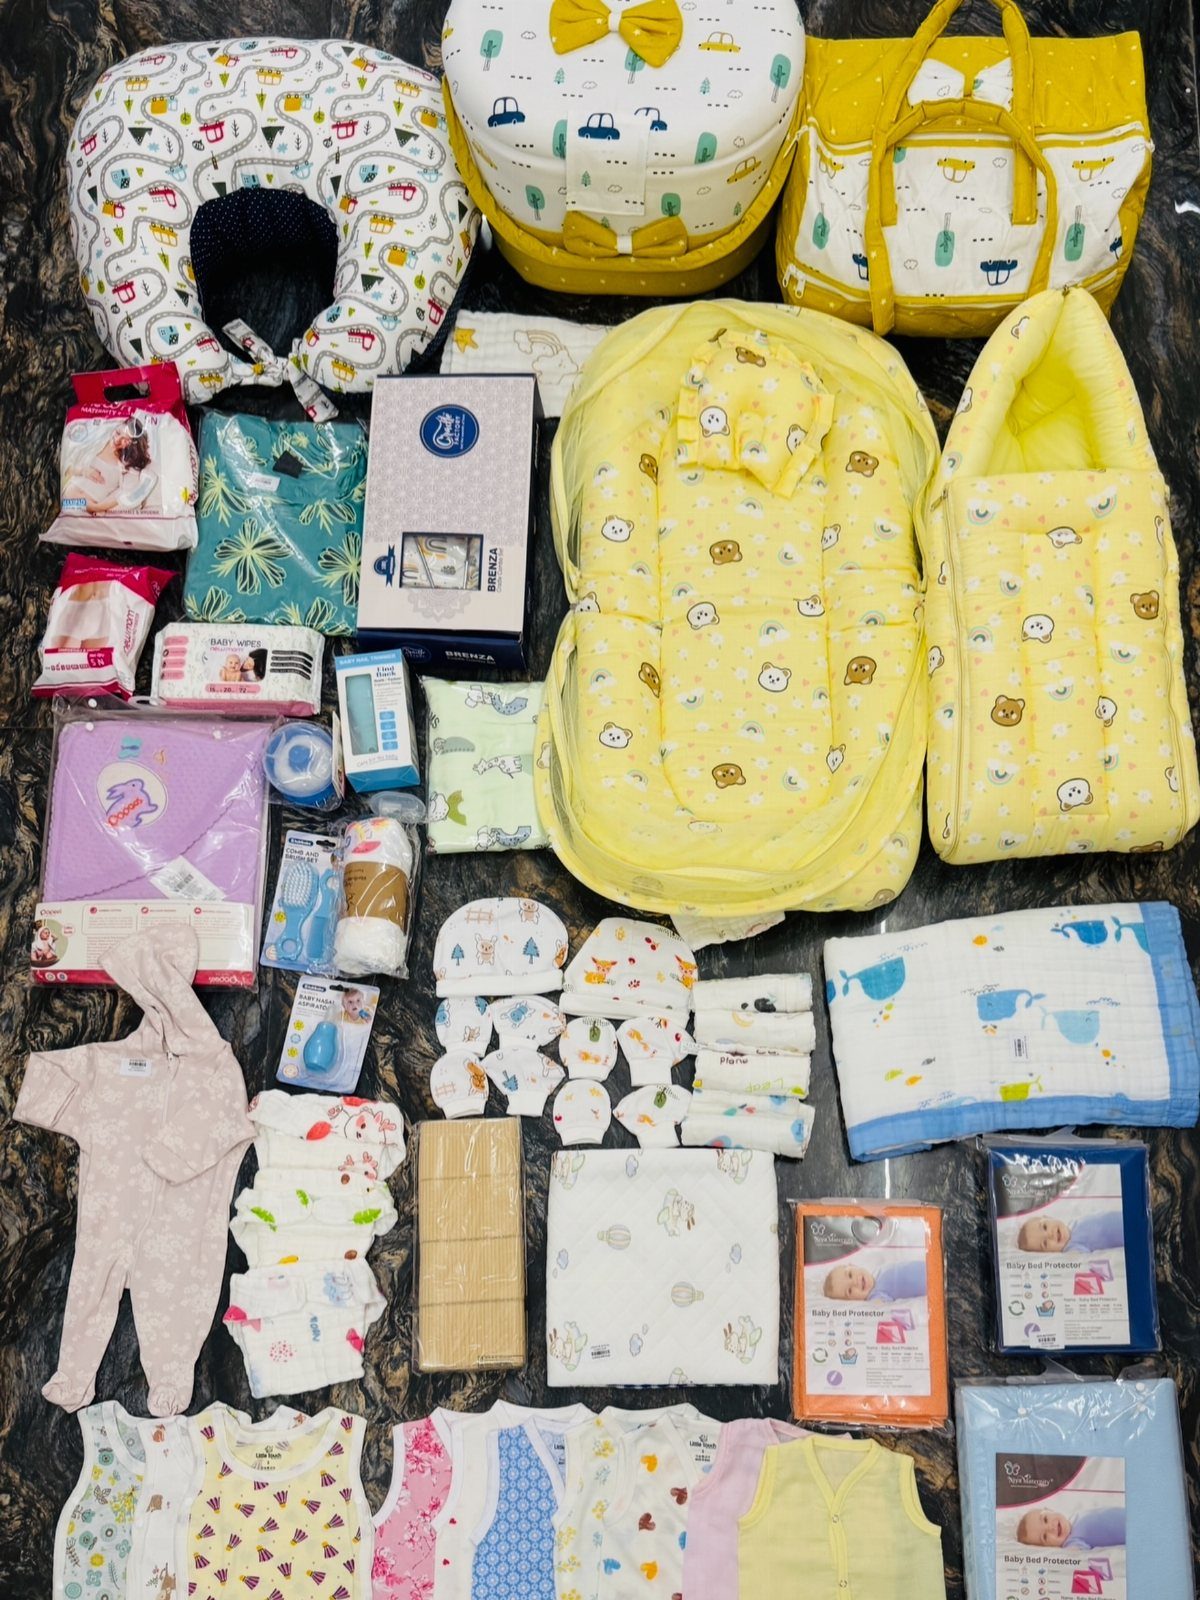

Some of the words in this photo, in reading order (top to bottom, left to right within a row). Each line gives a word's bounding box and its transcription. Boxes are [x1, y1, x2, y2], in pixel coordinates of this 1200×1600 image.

[487, 548, 498, 592] BRENZA
[210, 638, 234, 646] BABY
[237, 639, 262, 648] WIPES
[445, 650, 495, 661] BRENZA
[285, 847, 304, 856] COMB
[298, 993, 316, 1001] BABY
[1006, 1262, 1025, 1270] Baby
[811, 1309, 830, 1317] Baby
[833, 1309, 847, 1317] Bed
[848, 1309, 884, 1317] Protector
[1004, 1555, 1024, 1564] Baby
[1043, 1557, 1082, 1565] Protector
